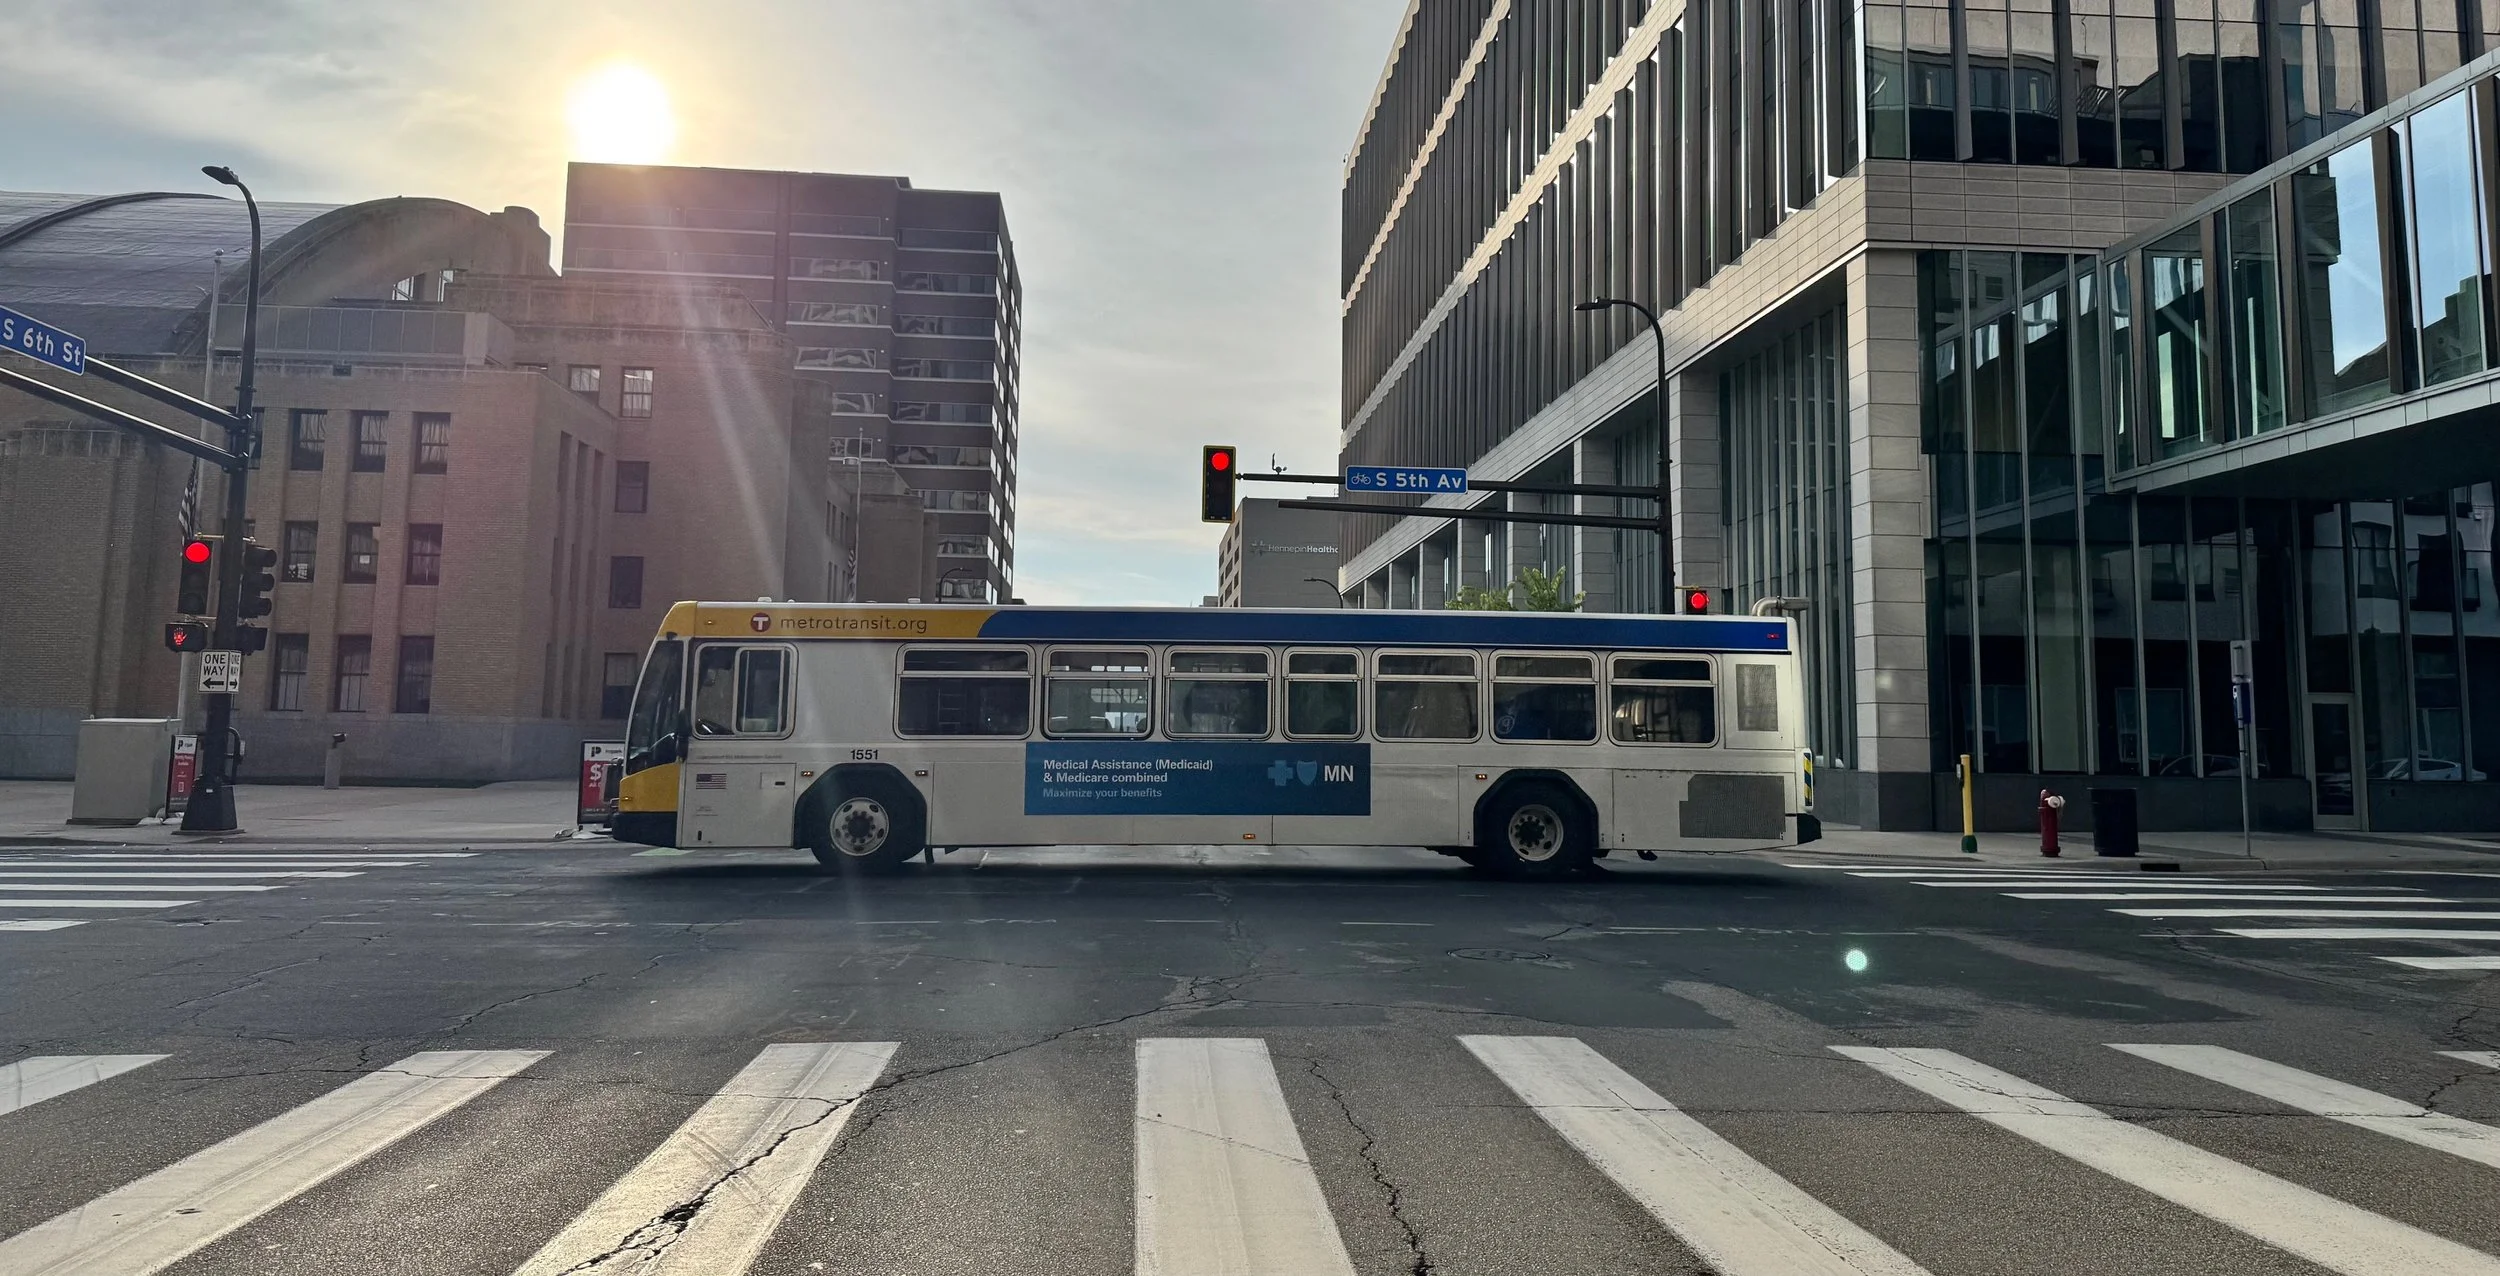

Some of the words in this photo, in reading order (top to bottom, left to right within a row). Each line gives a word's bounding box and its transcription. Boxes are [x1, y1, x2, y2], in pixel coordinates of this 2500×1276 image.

[2, 318, 15, 341] S
[23, 327, 55, 357] 6th
[62, 341, 81, 366] St
[1375, 472, 1388, 487] S
[1396, 472, 1429, 488] 5th
[1437, 473, 1463, 489] Av
[779, 615, 928, 634] metrotransit.org
[204, 653, 226, 665] ONE
[203, 665, 226, 676] WAY
[850, 749, 878, 761] 1551
[1043, 759, 1089, 770] Medical
[1091, 759, 1152, 770] Assistance
[1155, 759, 1213, 772] (Medicaid)
[1043, 772, 1053, 783] &
[1056, 772, 1109, 783] Medicare
[1111, 772, 1168, 783] combined
[1324, 764, 1354, 782] MN
[1043, 787, 1093, 798] Maximize
[1095, 790, 1118, 800] your
[1120, 787, 1163, 798] benefits
